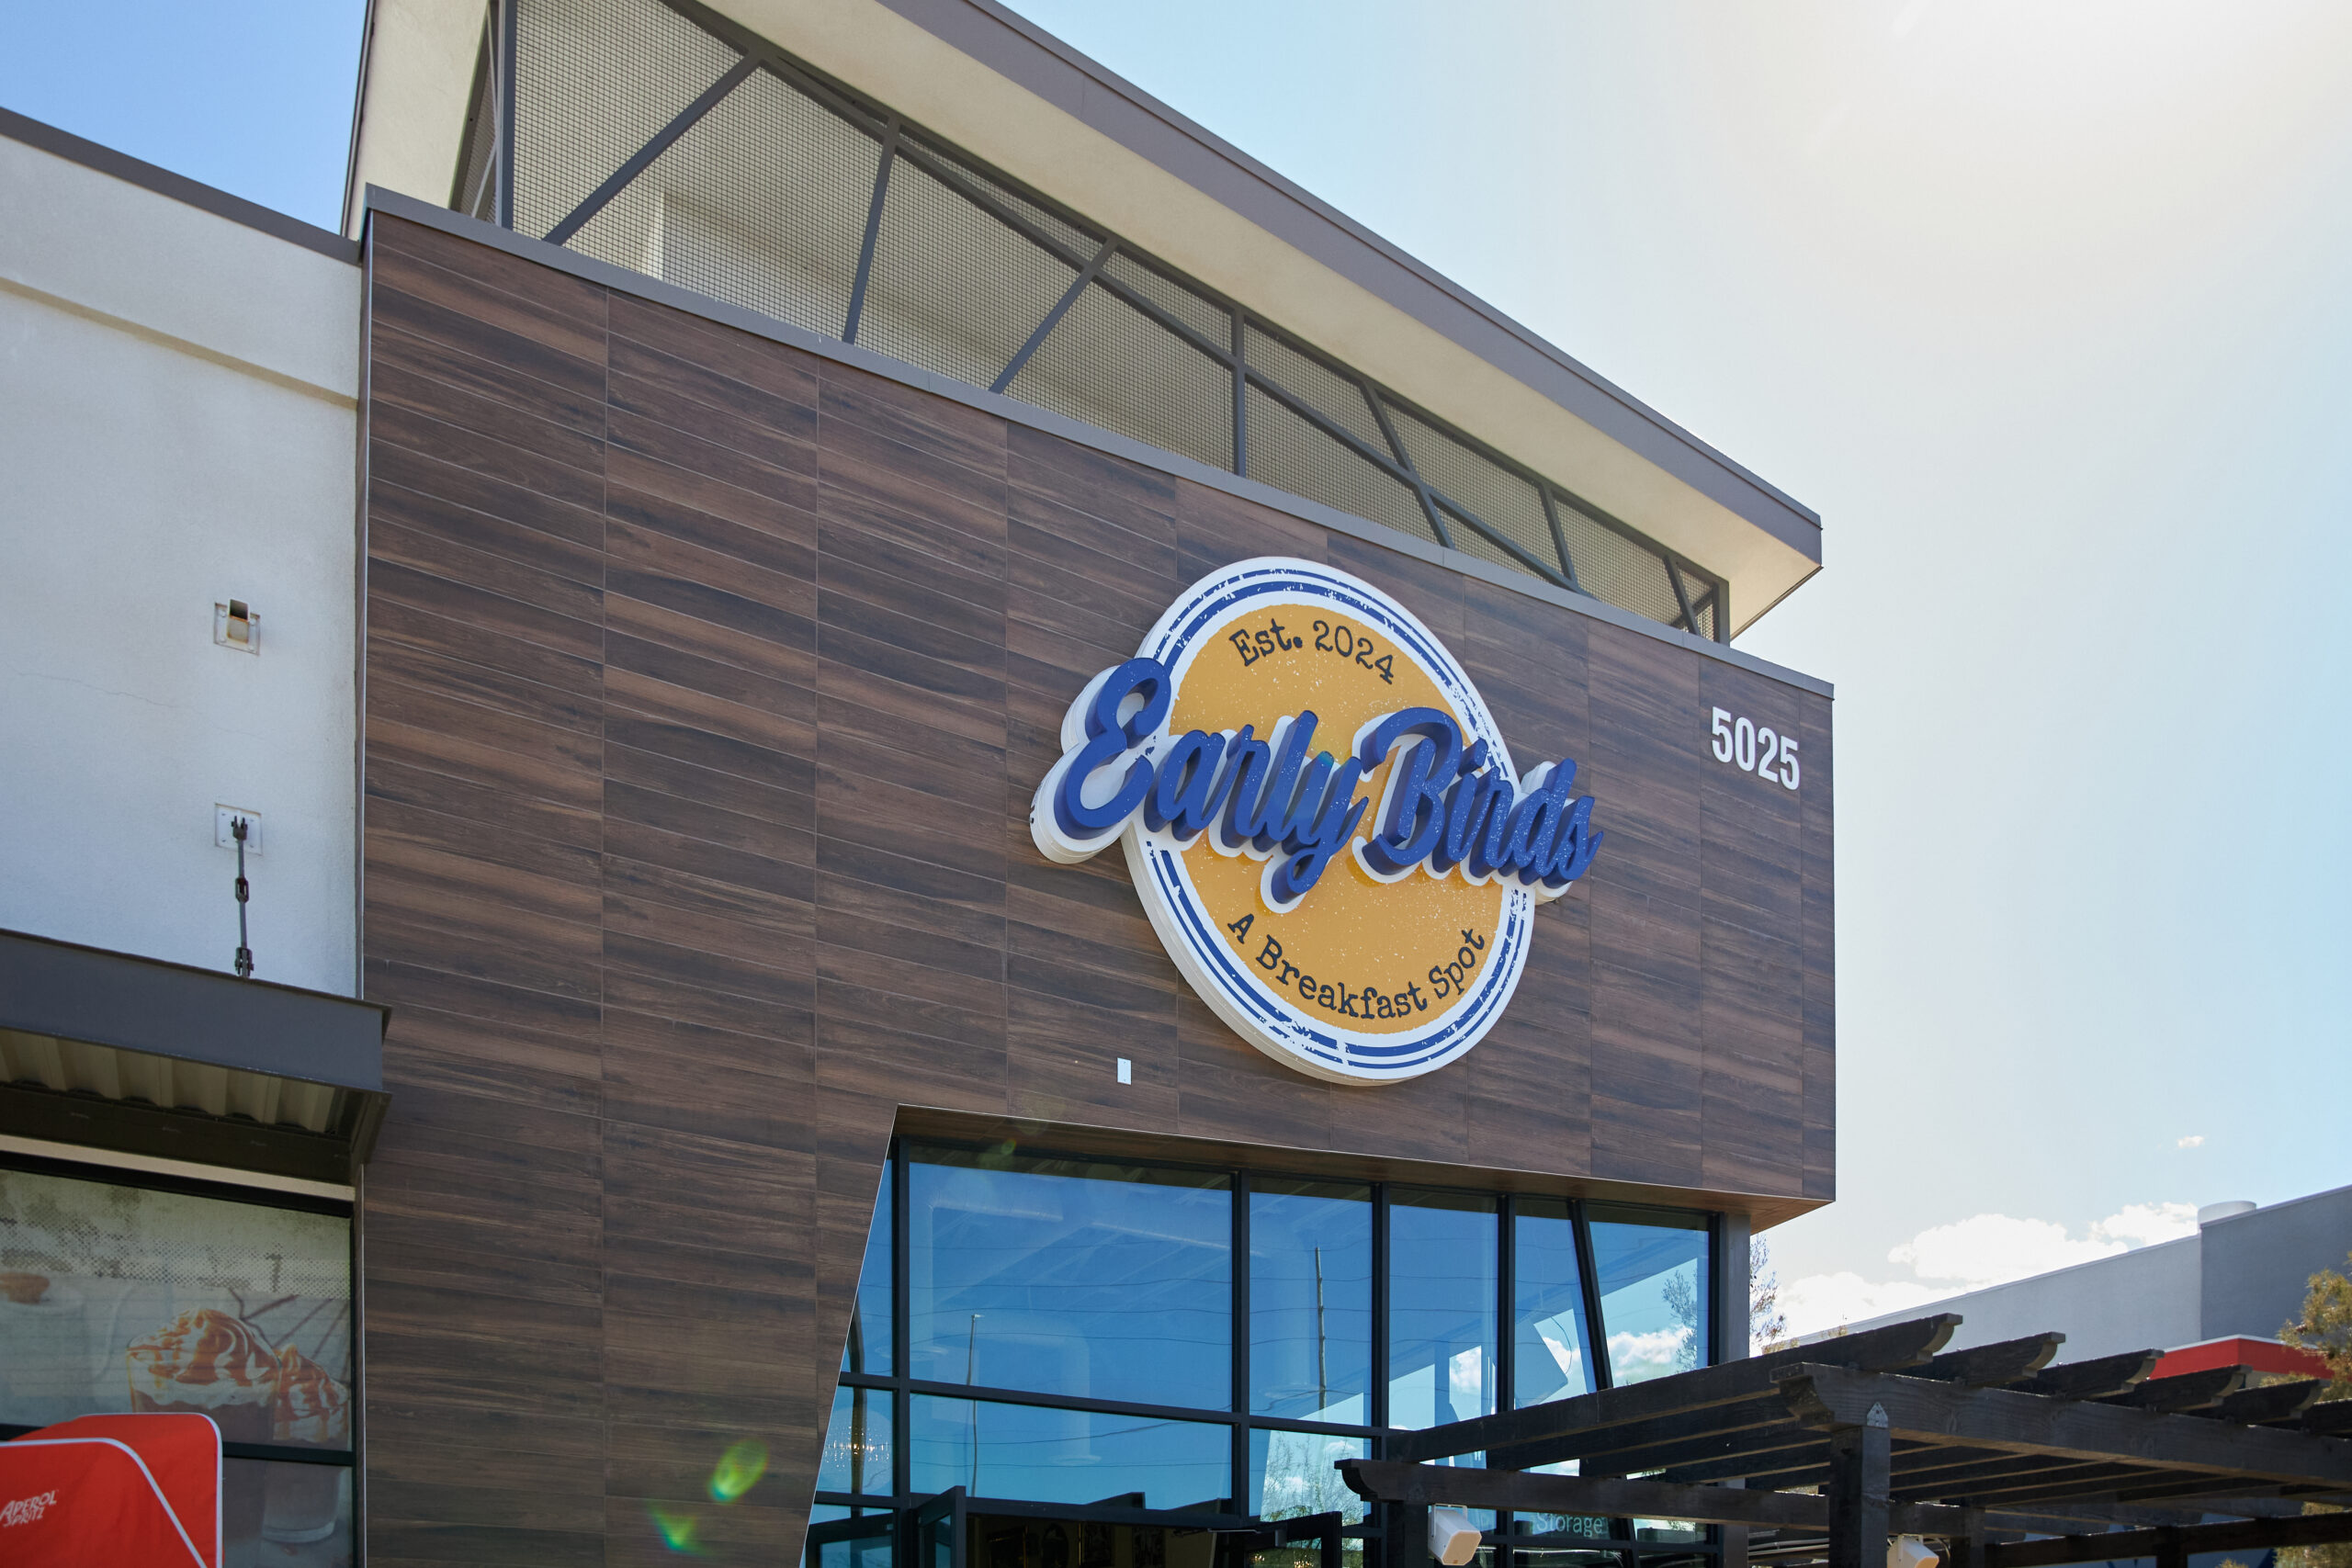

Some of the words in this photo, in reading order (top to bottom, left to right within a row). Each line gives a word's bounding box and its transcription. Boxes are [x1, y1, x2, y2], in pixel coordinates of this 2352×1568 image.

[1228, 617, 1304, 667] Est.
[1312, 619, 1395, 685] 2024
[1054, 657, 1369, 905] Early
[1360, 706, 1604, 886] Birds
[1711, 705, 1800, 791] 5025
[1227, 913, 1255, 944] A
[1255, 934, 1428, 1020] Breakfast
[1428, 928, 1486, 999] Spot
[0, 1489, 58, 1524] APEROL
[1536, 1512, 1603, 1538] Storage
